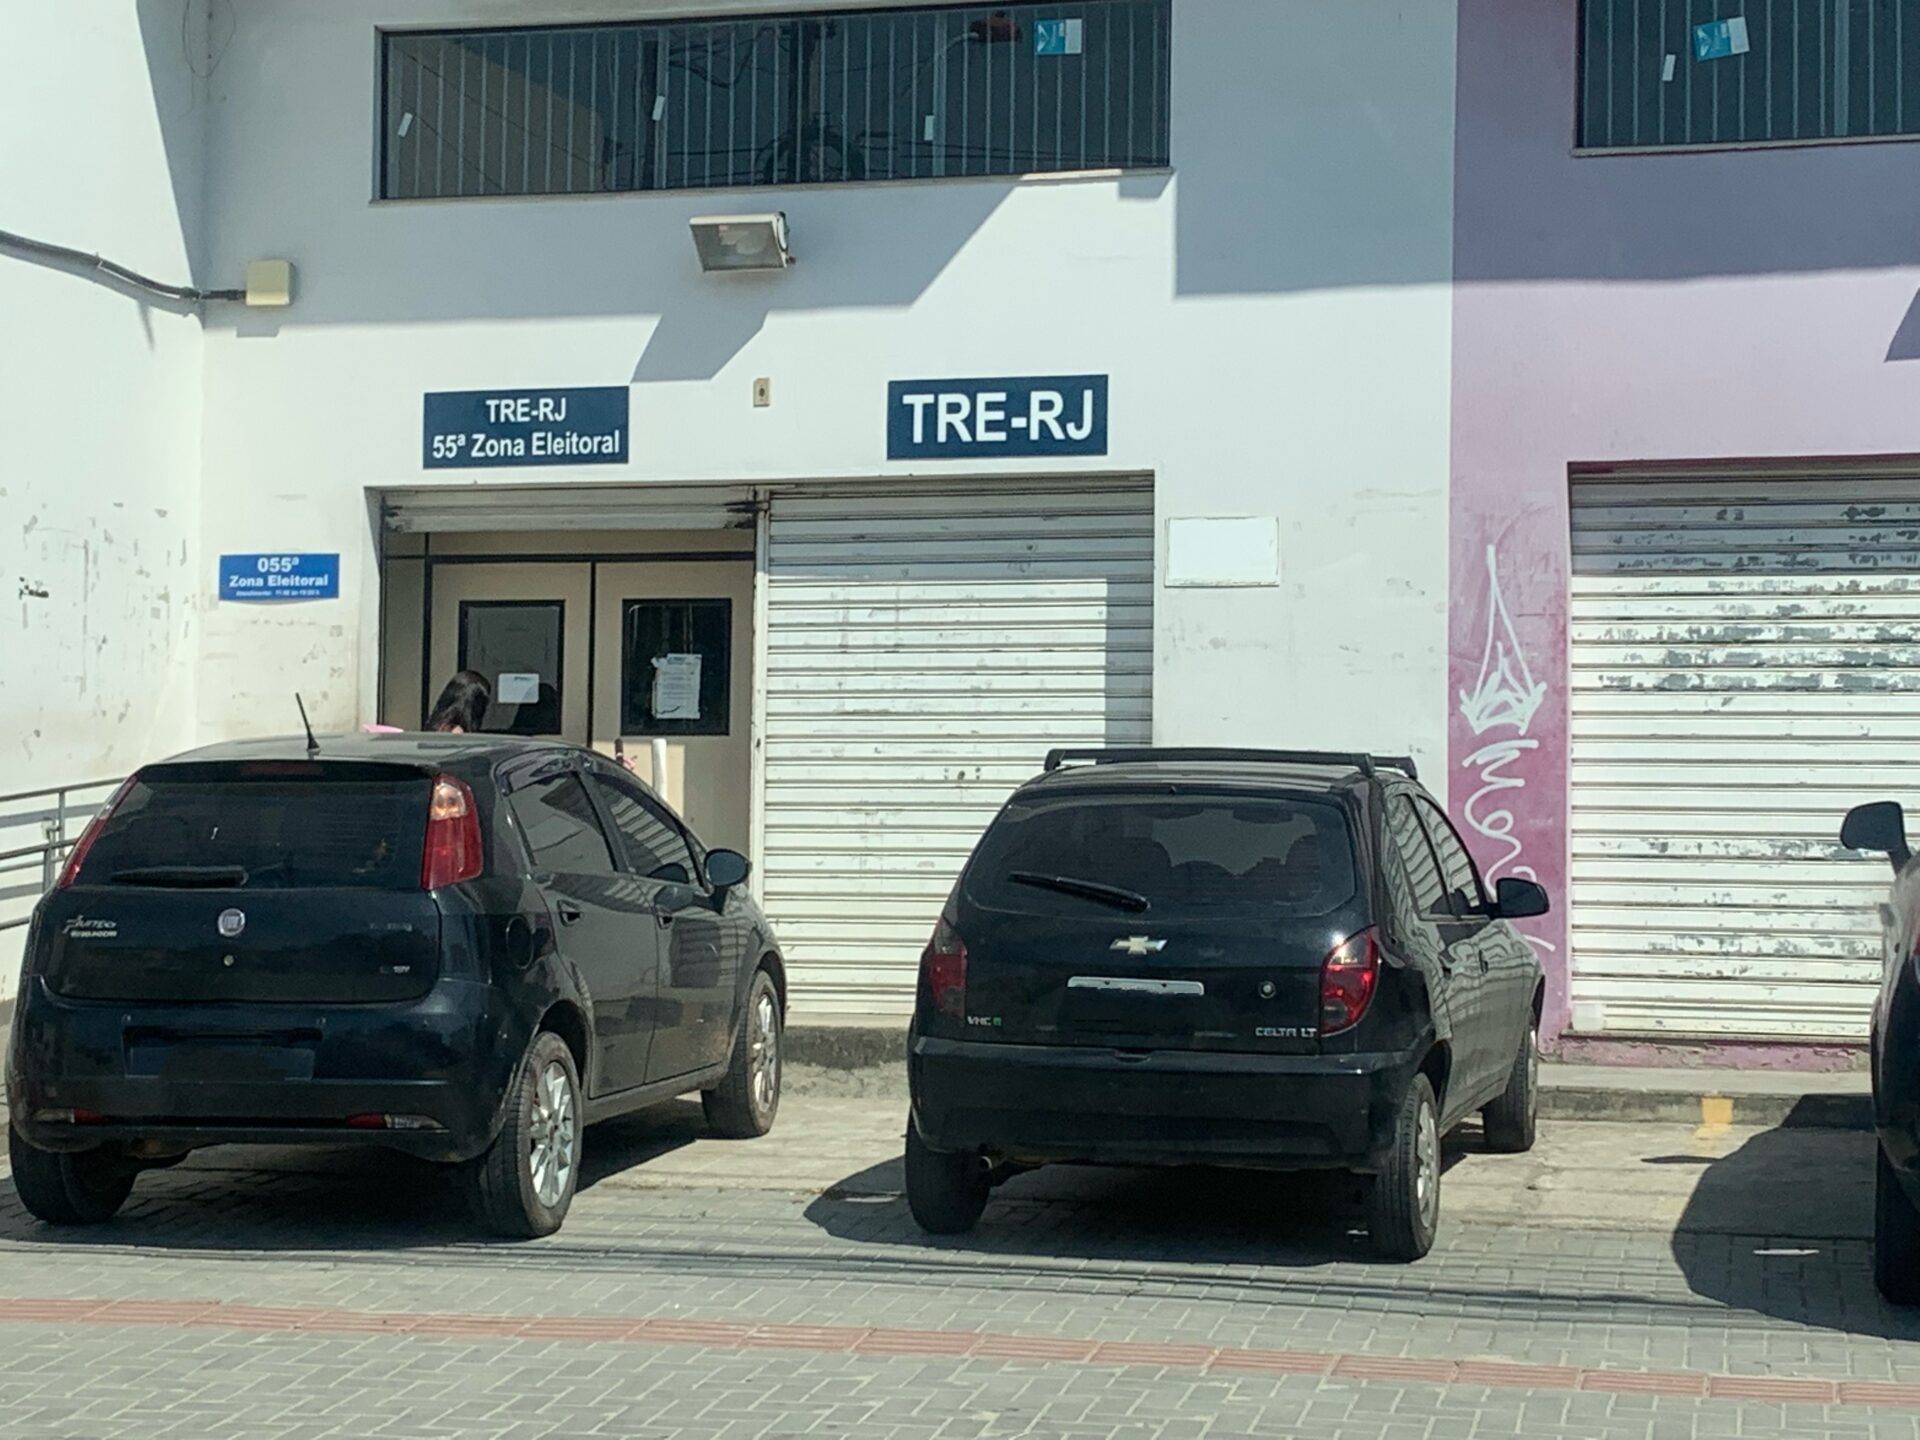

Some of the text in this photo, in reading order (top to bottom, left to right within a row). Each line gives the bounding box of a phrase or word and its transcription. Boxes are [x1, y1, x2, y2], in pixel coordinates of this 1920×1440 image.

[486, 397, 567, 424] TRE-RJ
[902, 389, 1093, 444] TRE-RJ
[432, 429, 620, 459] 55ª Zona Eleitoral
[257, 557, 300, 573] 055ª
[229, 574, 328, 588] Zona Eleitoral
[1255, 1027, 1318, 1038] CELTA LT
